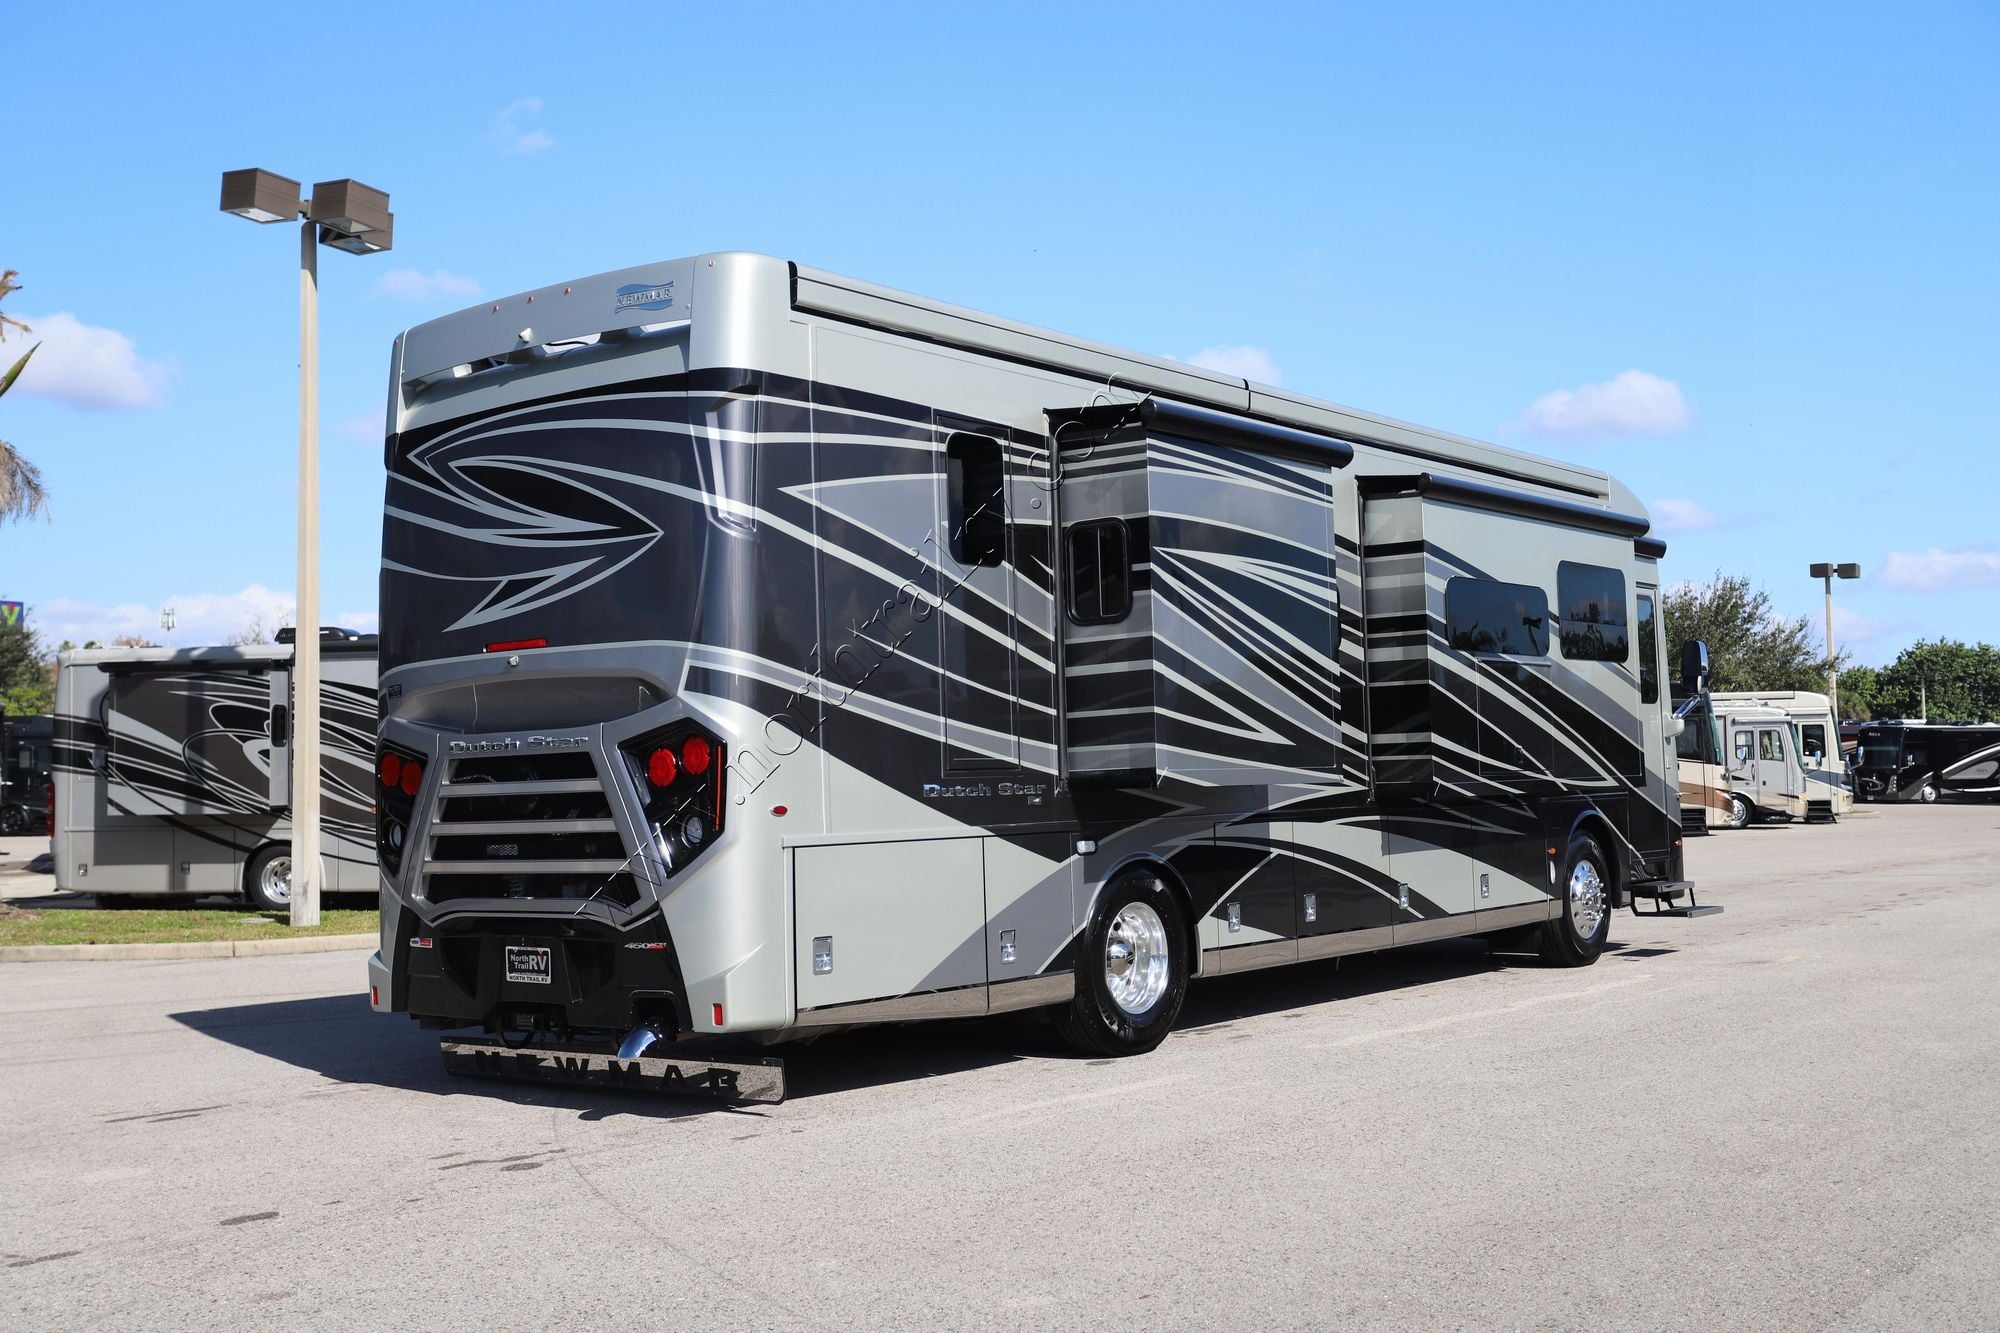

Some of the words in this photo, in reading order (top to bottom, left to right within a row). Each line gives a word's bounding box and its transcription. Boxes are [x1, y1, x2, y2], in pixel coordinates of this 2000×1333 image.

[616, 287, 673, 306] NEWMAR
[450, 737, 521, 754] Dutch
[527, 735, 589, 750] Star
[923, 783, 992, 798] Dutch
[998, 782, 1046, 796] Star
[510, 954, 529, 962] North
[513, 962, 529, 970] Trail
[528, 955, 547, 971] RV
[474, 1050, 742, 1097] NEWMAR
